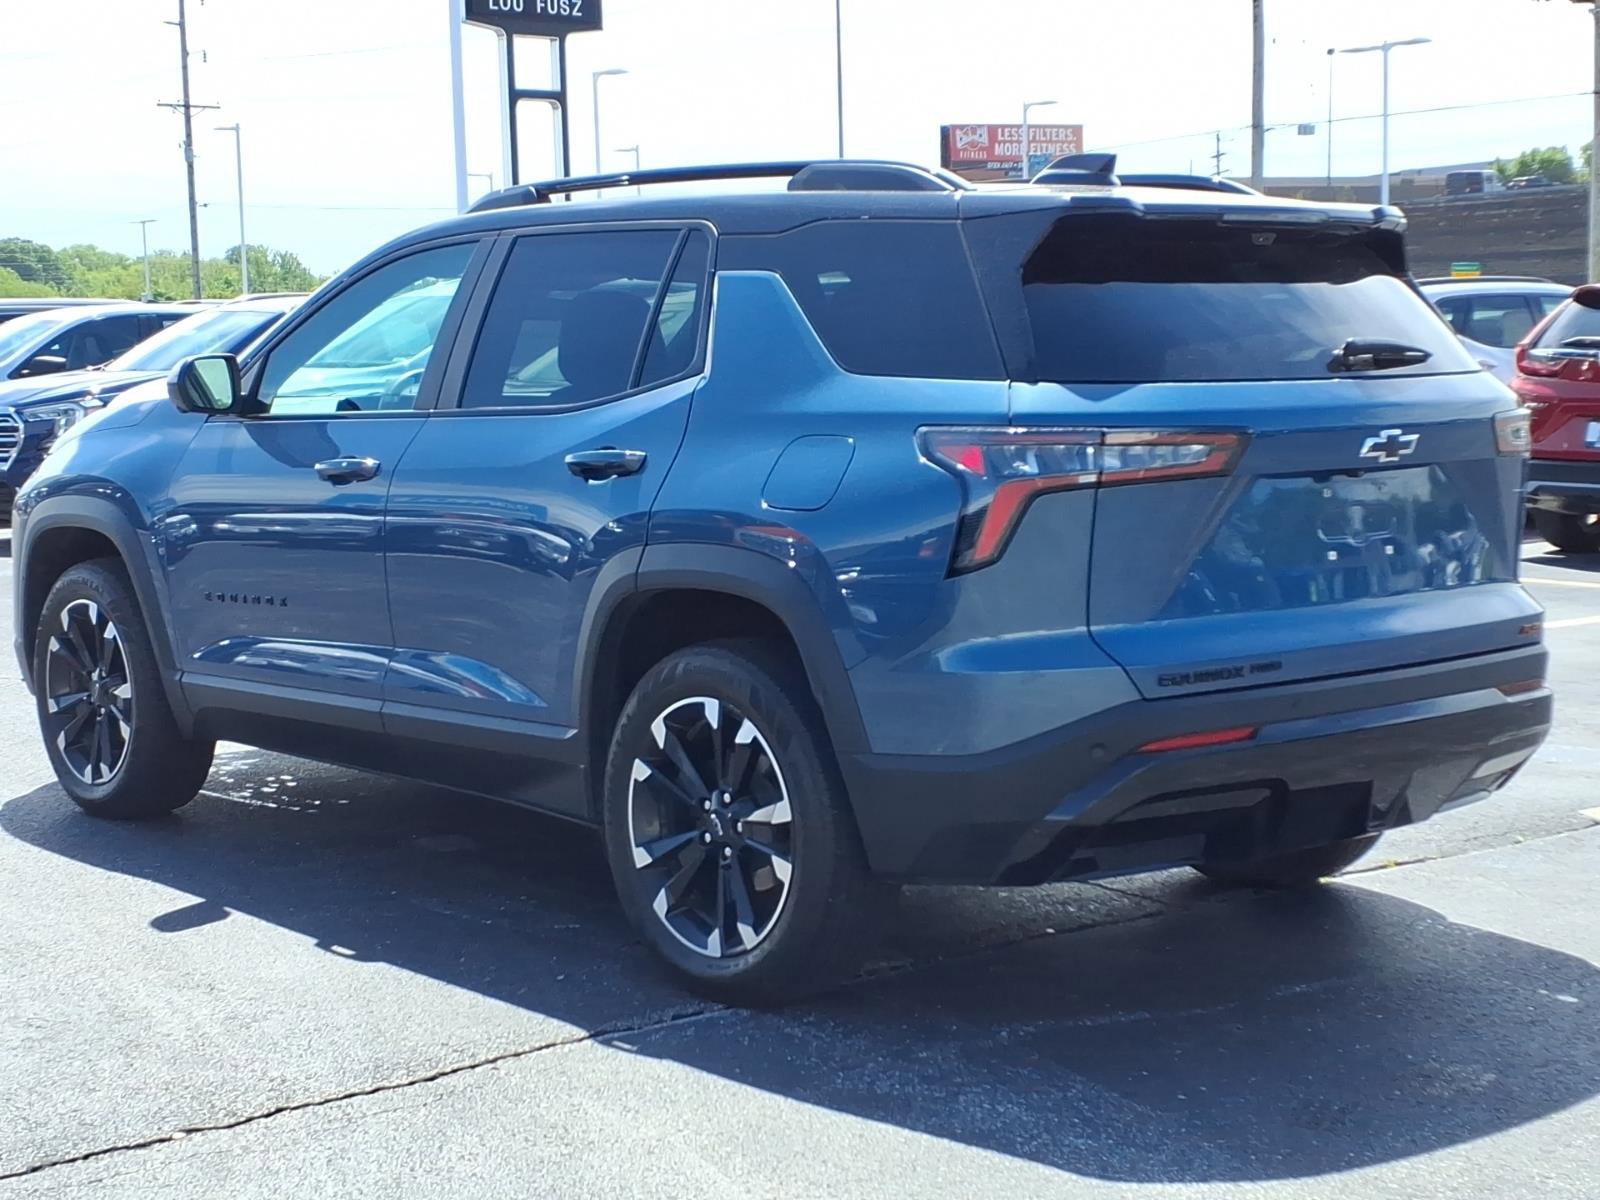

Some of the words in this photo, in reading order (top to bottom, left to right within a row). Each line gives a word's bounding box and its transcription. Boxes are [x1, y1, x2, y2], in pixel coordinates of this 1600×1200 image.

[488, 0, 523, 12] LOU
[536, 0, 582, 16] FUSZ
[998, 128, 1024, 141] LESS
[1028, 128, 1077, 141] FILTERS.
[1157, 665, 1245, 687] EQUINOX
